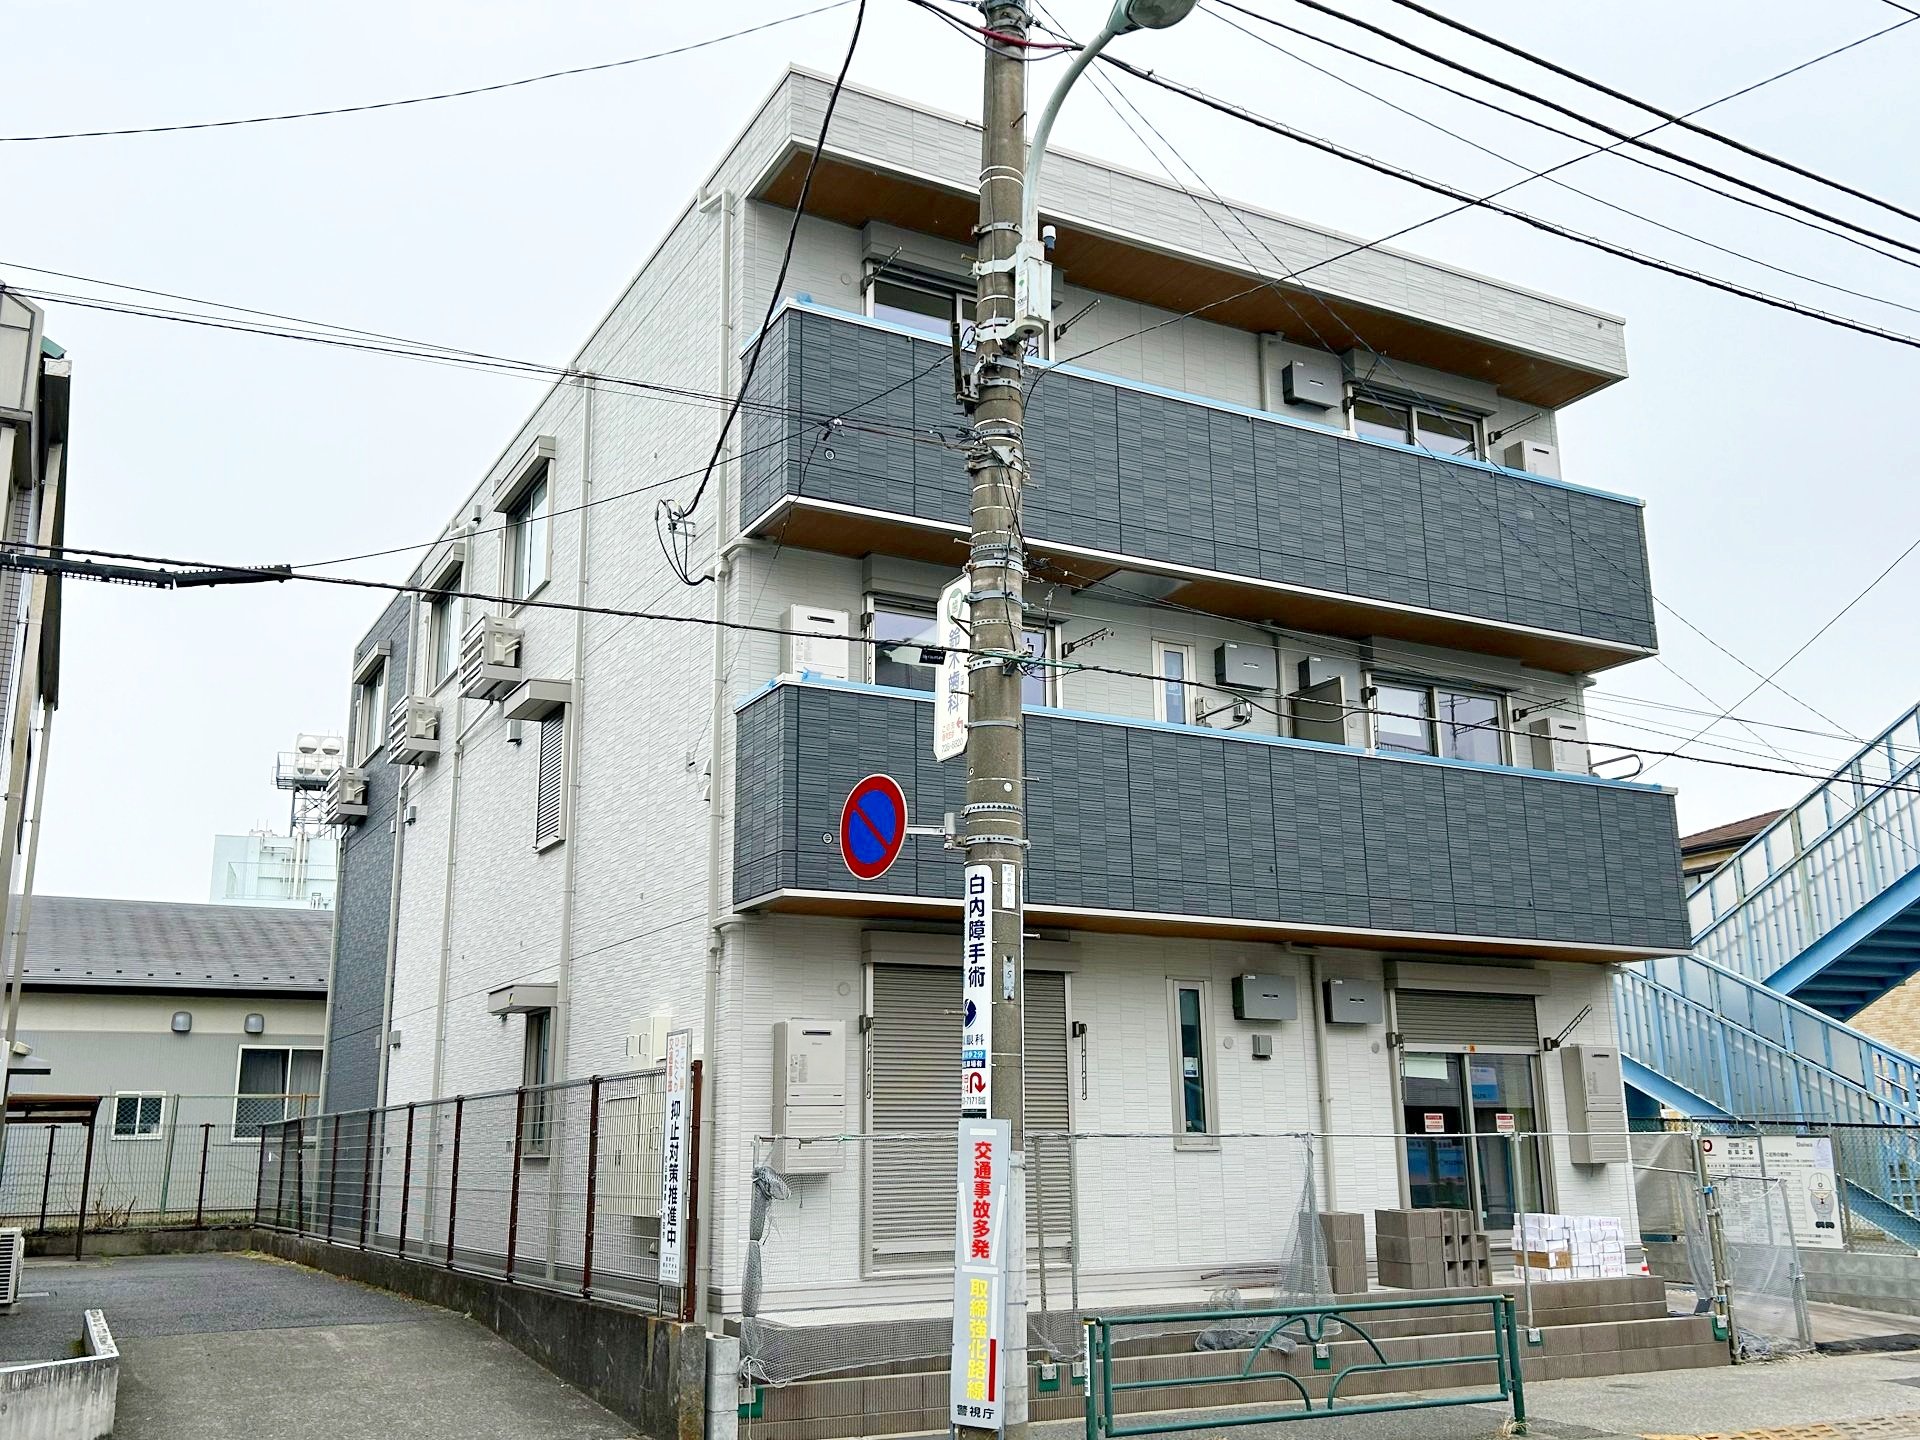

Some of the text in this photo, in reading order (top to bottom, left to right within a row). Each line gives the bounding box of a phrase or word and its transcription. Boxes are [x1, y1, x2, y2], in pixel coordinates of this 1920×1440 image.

[947, 626, 961, 716] 鈴木歯科
[968, 874, 986, 988] 白内障手術
[962, 1033, 985, 1046] 眼科
[666, 1099, 681, 1248] 抑止対策推進中
[971, 1140, 992, 1260] 交通事故多発
[966, 1278, 988, 1402] 取締強化路線
[956, 1403, 995, 1420] 警視庁
